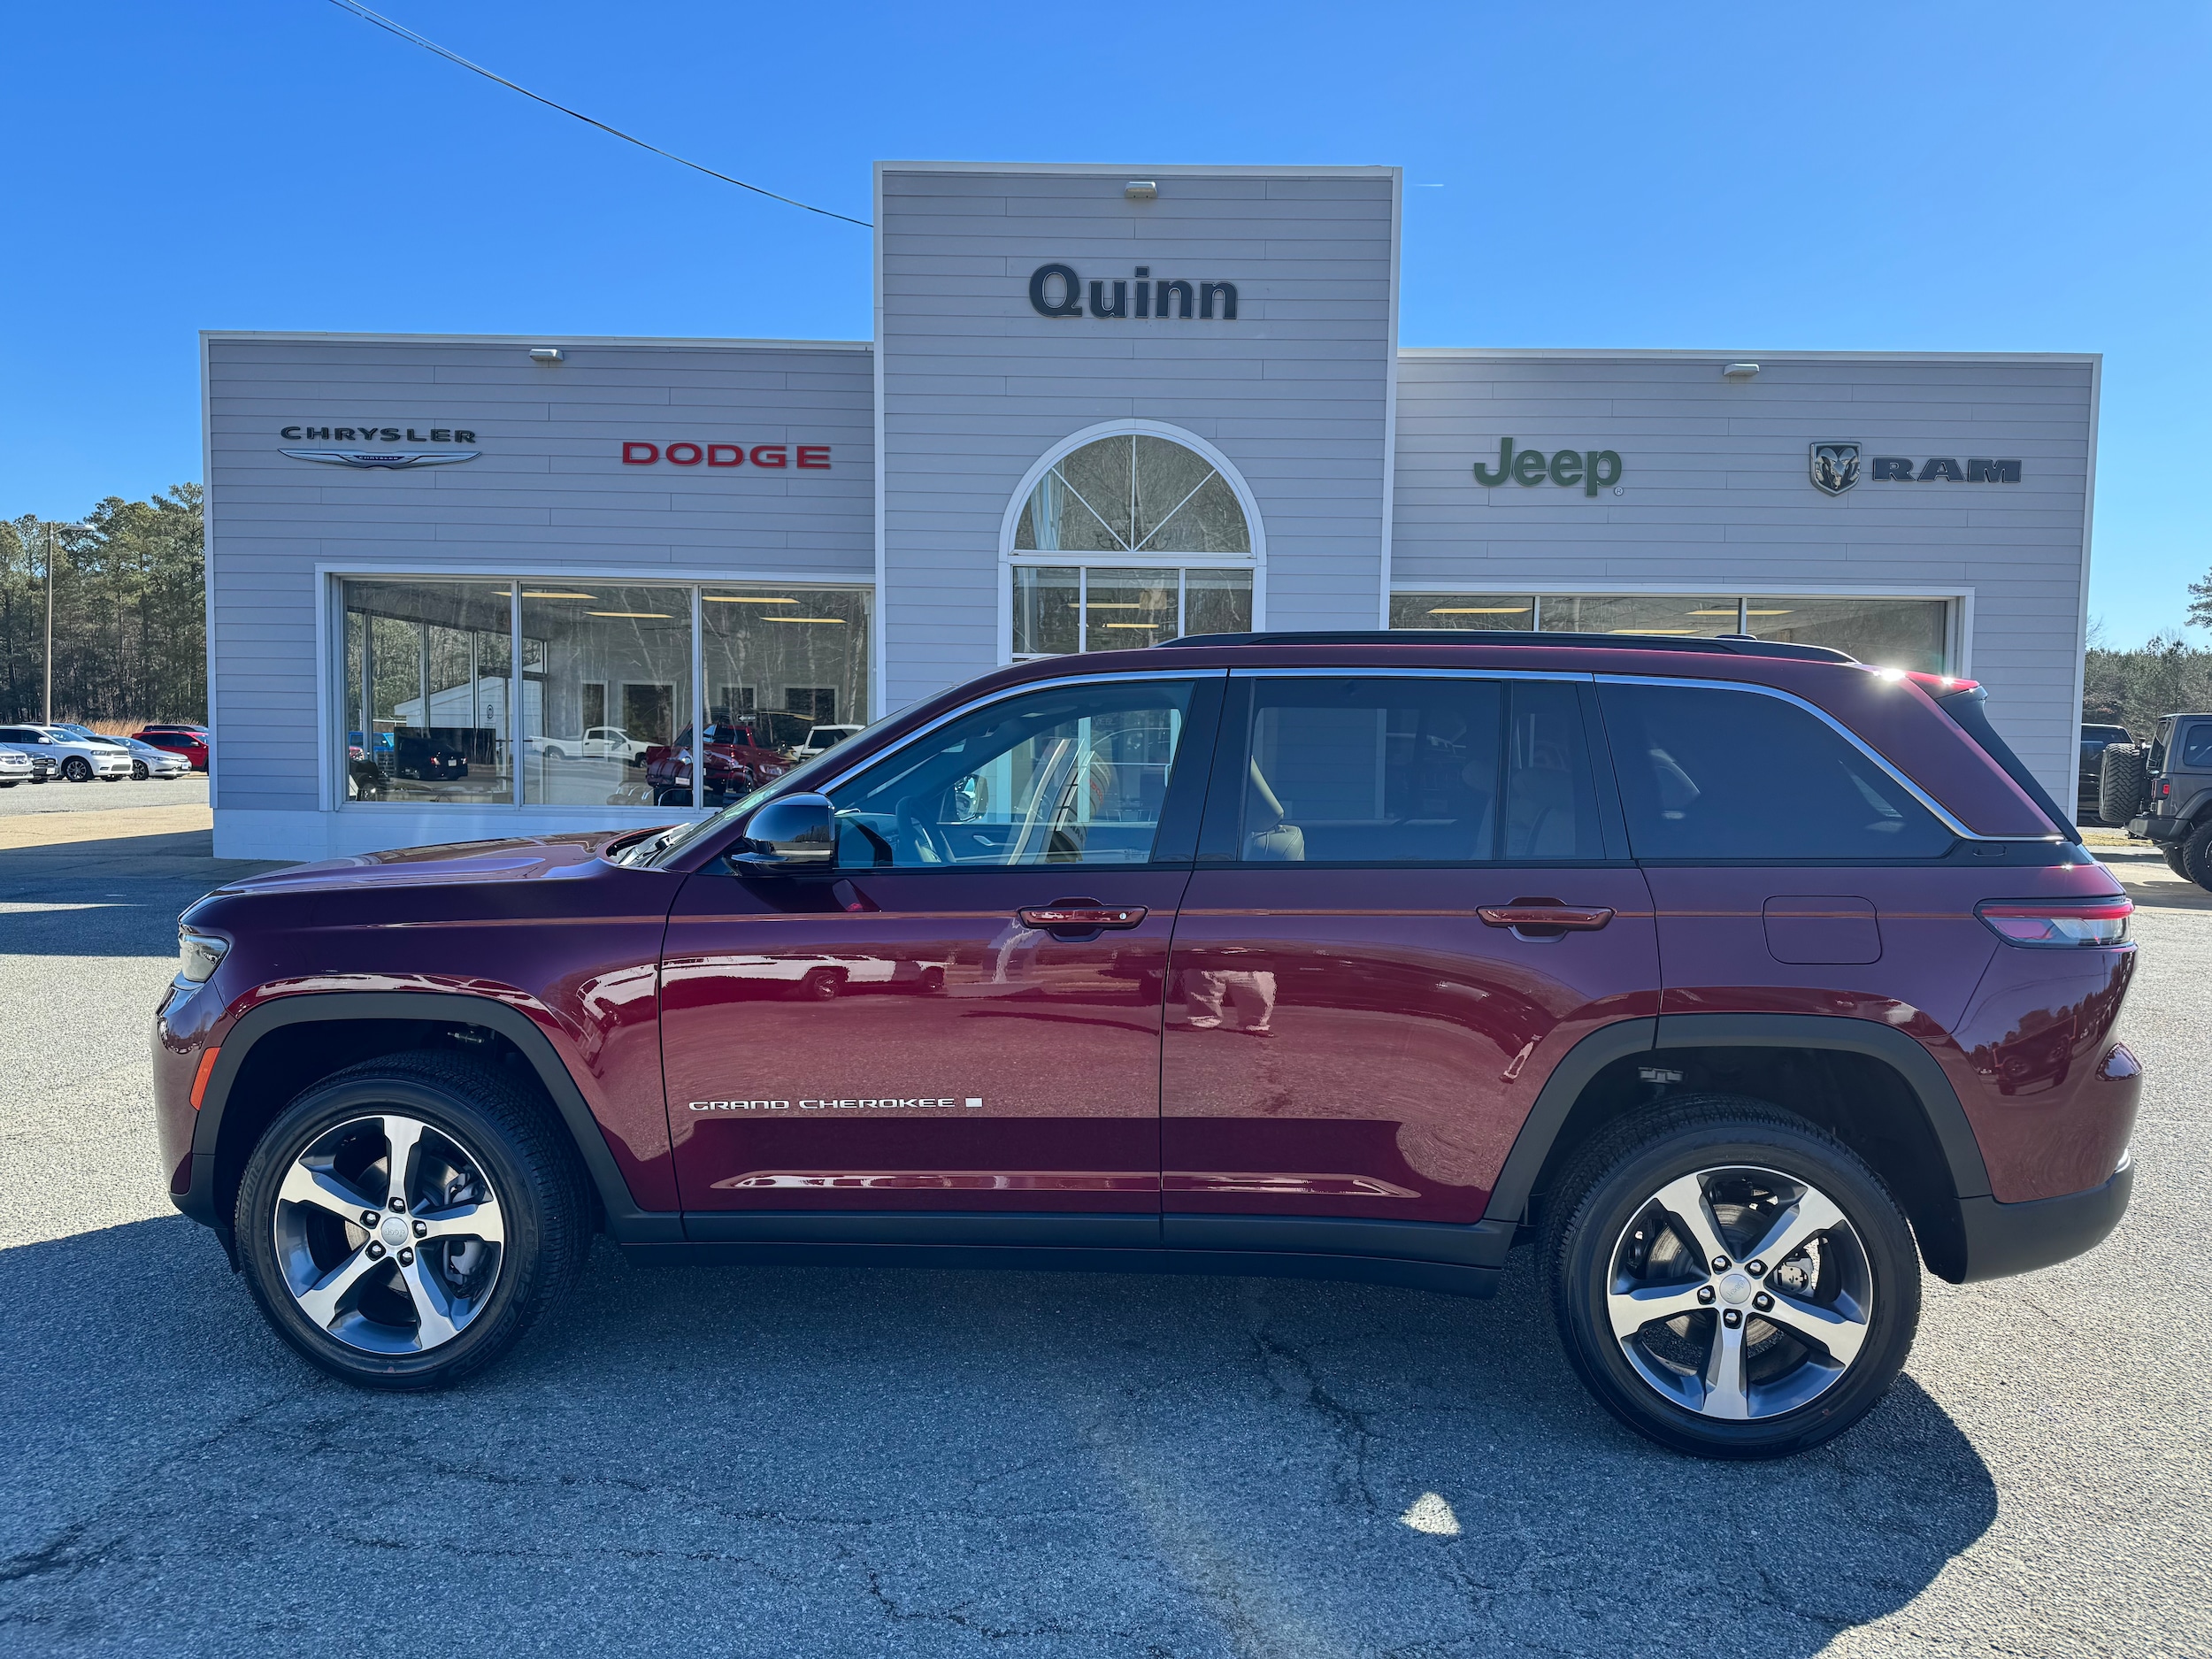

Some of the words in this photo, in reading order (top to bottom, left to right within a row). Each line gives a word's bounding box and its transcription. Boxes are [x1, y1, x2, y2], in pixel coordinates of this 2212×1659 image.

[1029, 263, 1238, 319] Quinn
[280, 426, 476, 442] CHRYSLER
[622, 442, 831, 469] DODGE
[1473, 437, 1622, 497] Jeep
[1872, 457, 2022, 483] RAM
[688, 1099, 790, 1110] GRAND
[798, 1097, 956, 1109] CHEROKEE
